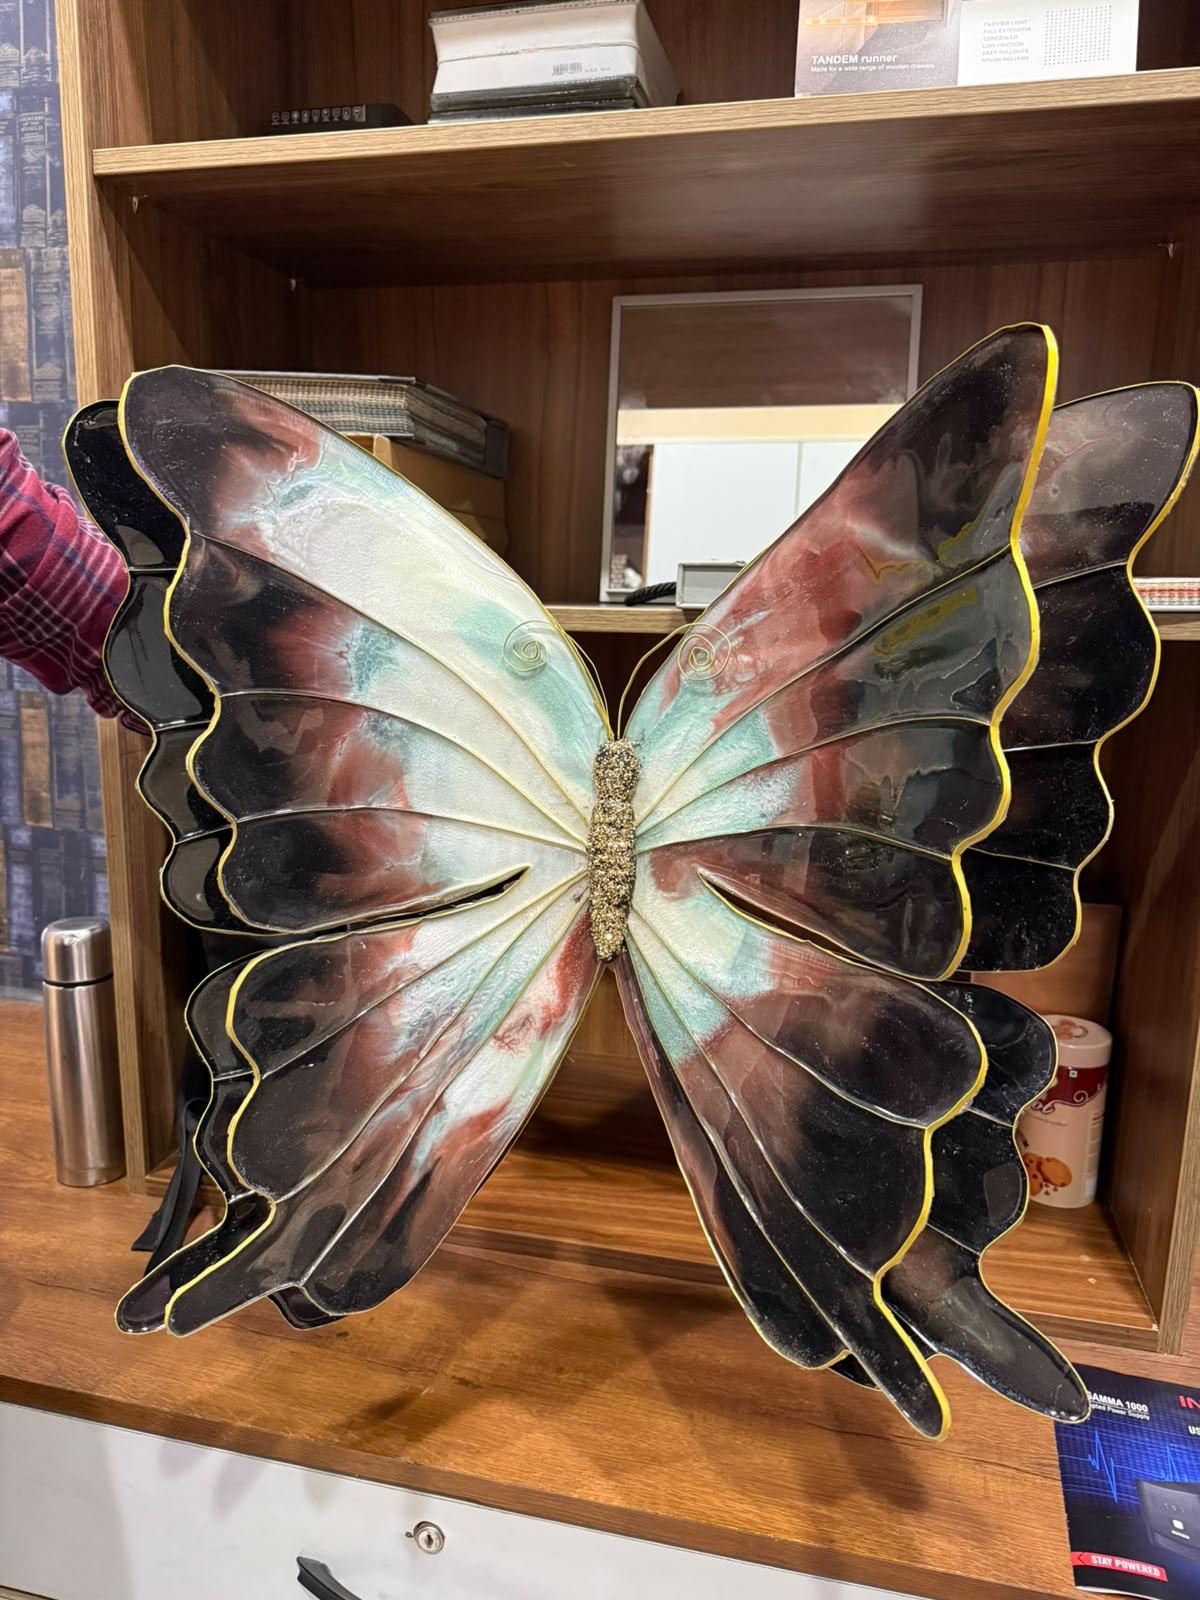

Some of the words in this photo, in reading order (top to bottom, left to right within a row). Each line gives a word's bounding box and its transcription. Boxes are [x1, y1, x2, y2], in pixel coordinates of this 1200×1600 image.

[811, 54, 859, 65] TANDEM
[861, 54, 898, 63] runner
[1107, 1407, 1126, 1415] Power
[1125, 1401, 1148, 1412] 1000
[1091, 1555, 1112, 1566] STAY
[1114, 1559, 1160, 1577] POWERED
